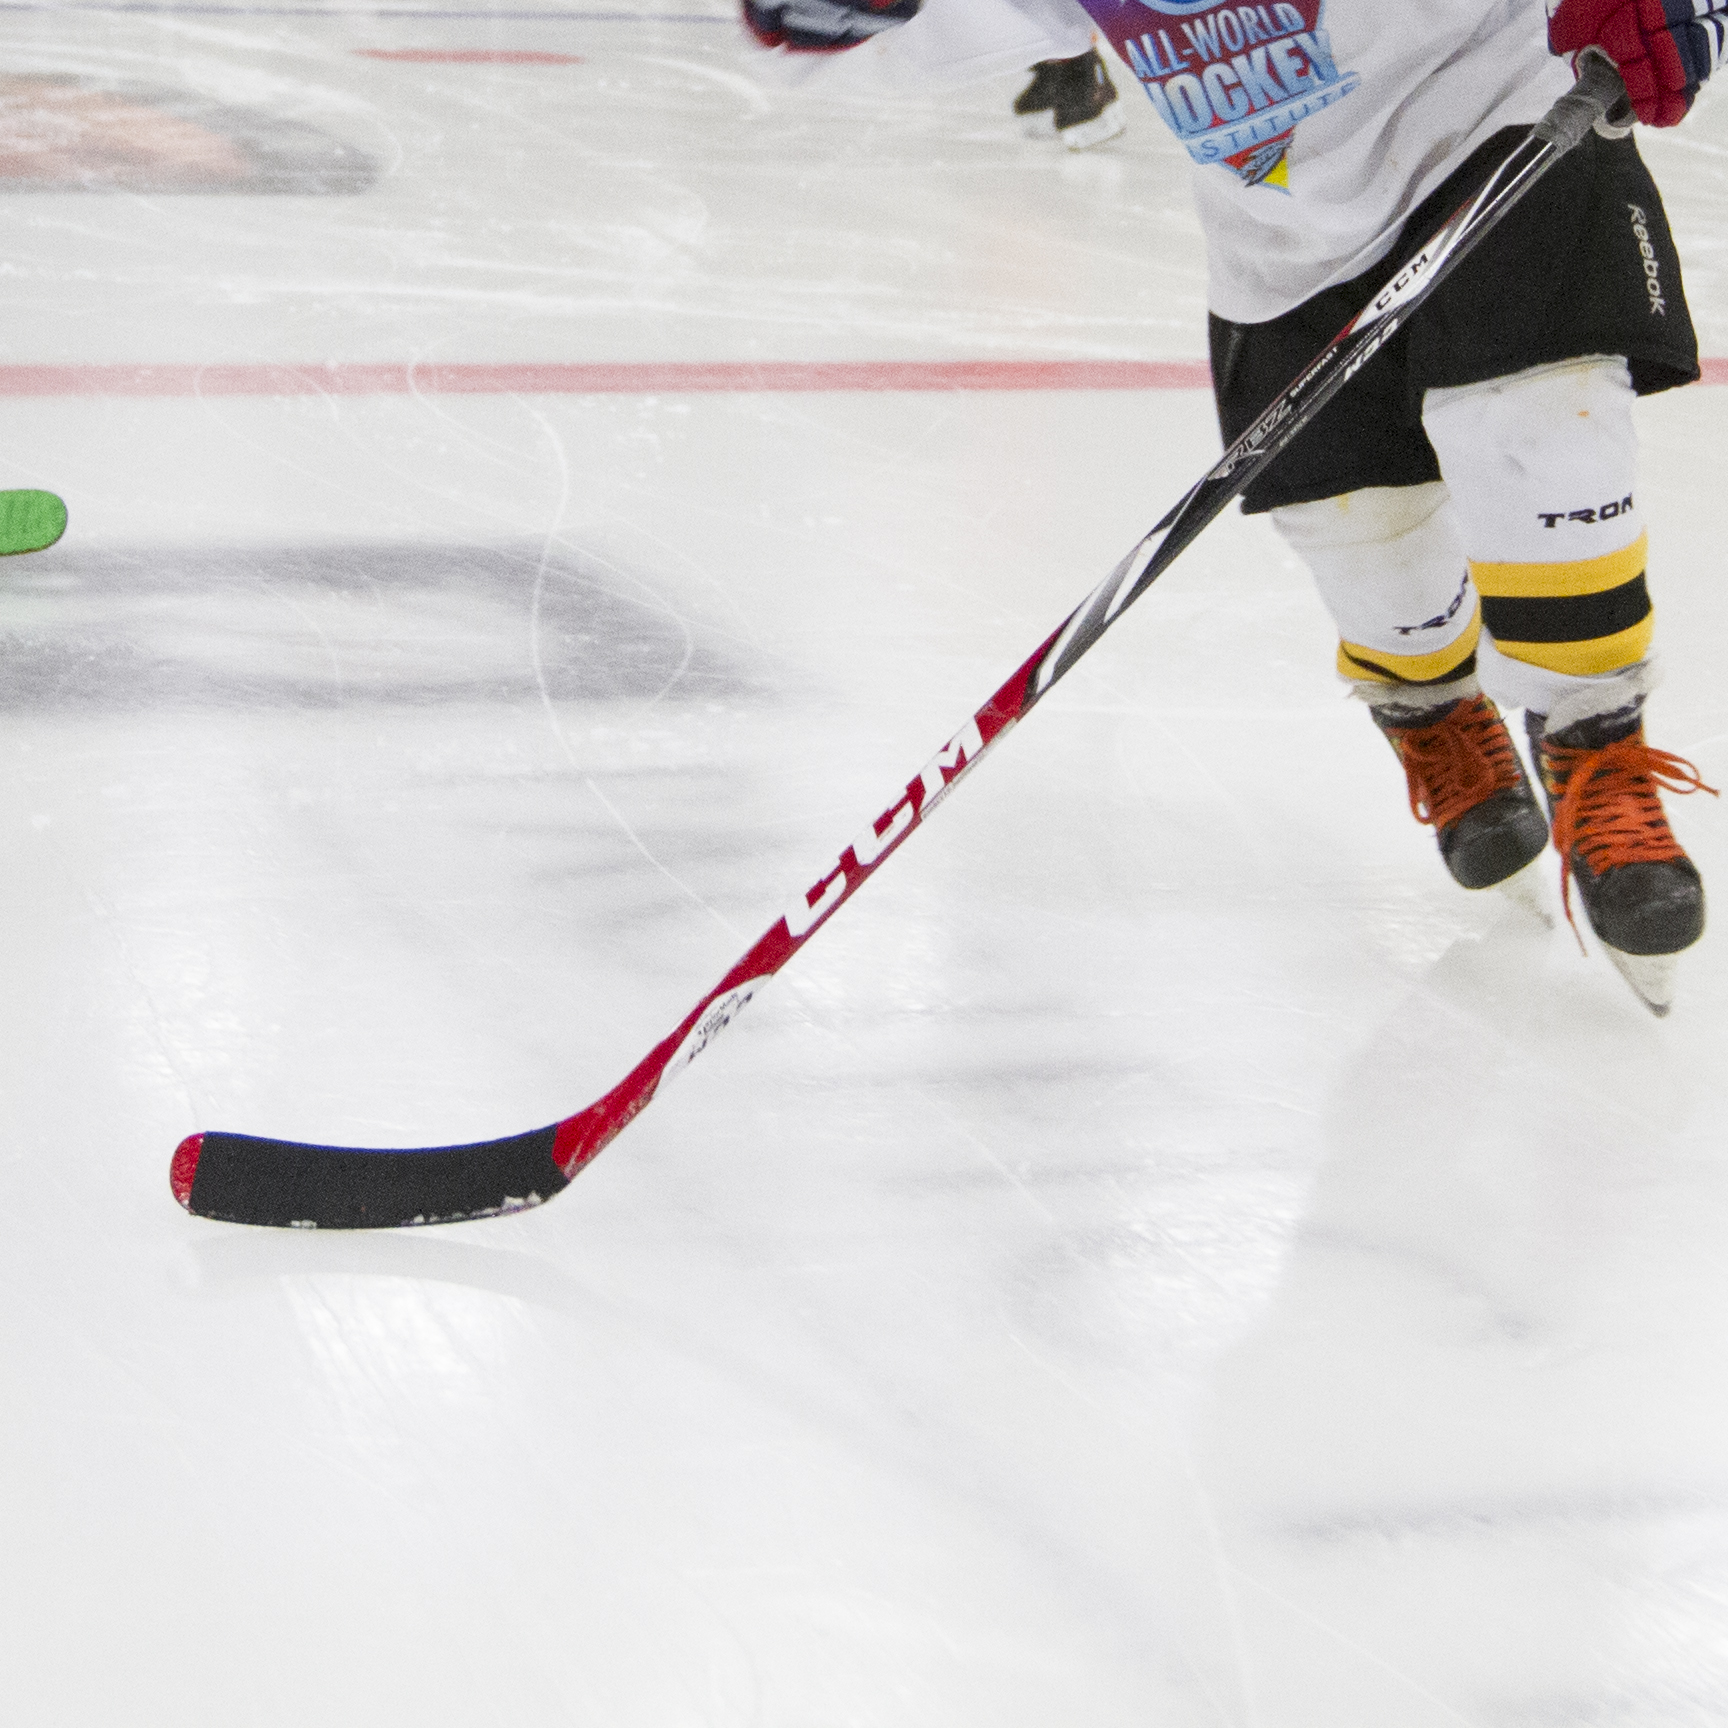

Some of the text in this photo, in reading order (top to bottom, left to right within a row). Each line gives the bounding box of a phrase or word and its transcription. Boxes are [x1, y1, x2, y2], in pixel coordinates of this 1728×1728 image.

[1124, 1, 1306, 80] ALL-WORLD
[1375, 253, 1430, 311] CCM
[1626, 203, 1665, 316] Reebok
[1289, 346, 1339, 398] SUPERFAST
[782, 712, 984, 940] CCM
